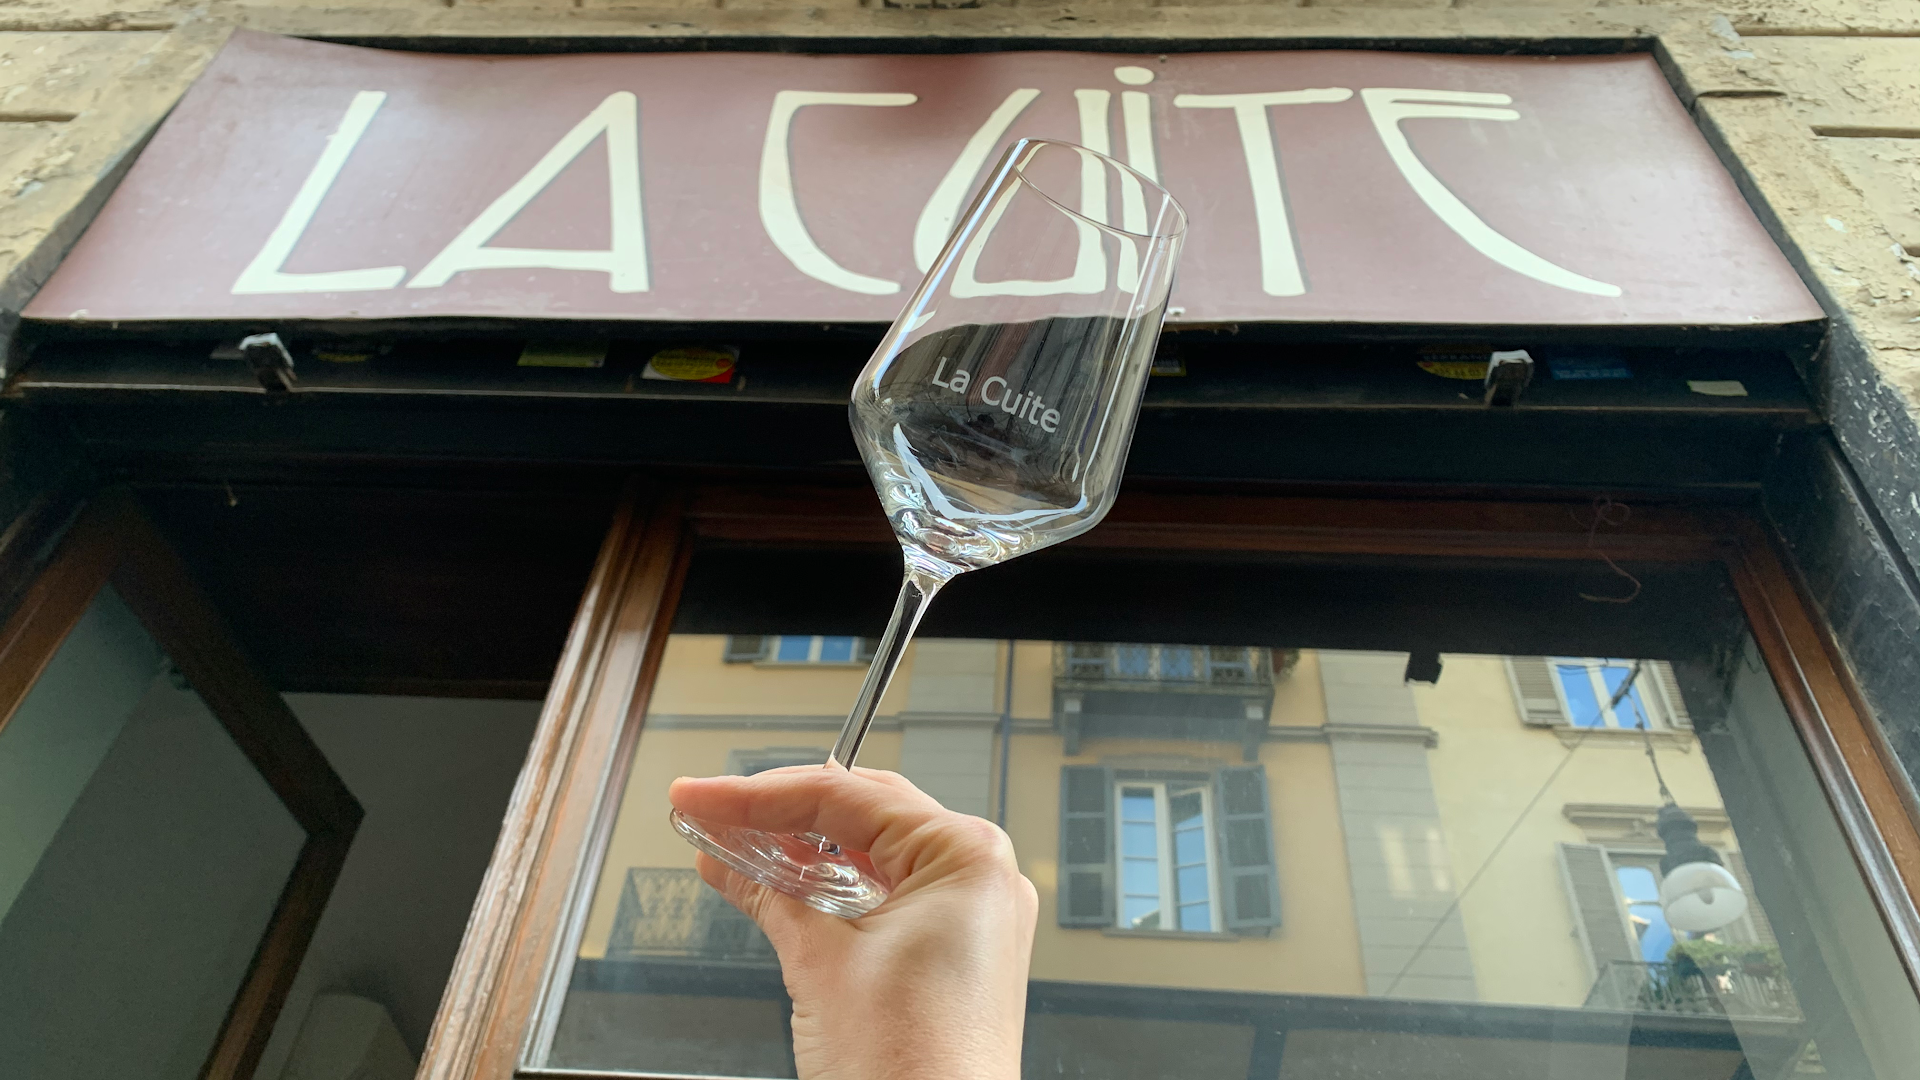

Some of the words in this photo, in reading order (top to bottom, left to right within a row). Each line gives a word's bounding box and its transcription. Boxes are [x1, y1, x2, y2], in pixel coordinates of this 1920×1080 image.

[231, 91, 649, 294] LA
[932, 356, 971, 394] La
[981, 376, 1061, 433] Cuite
